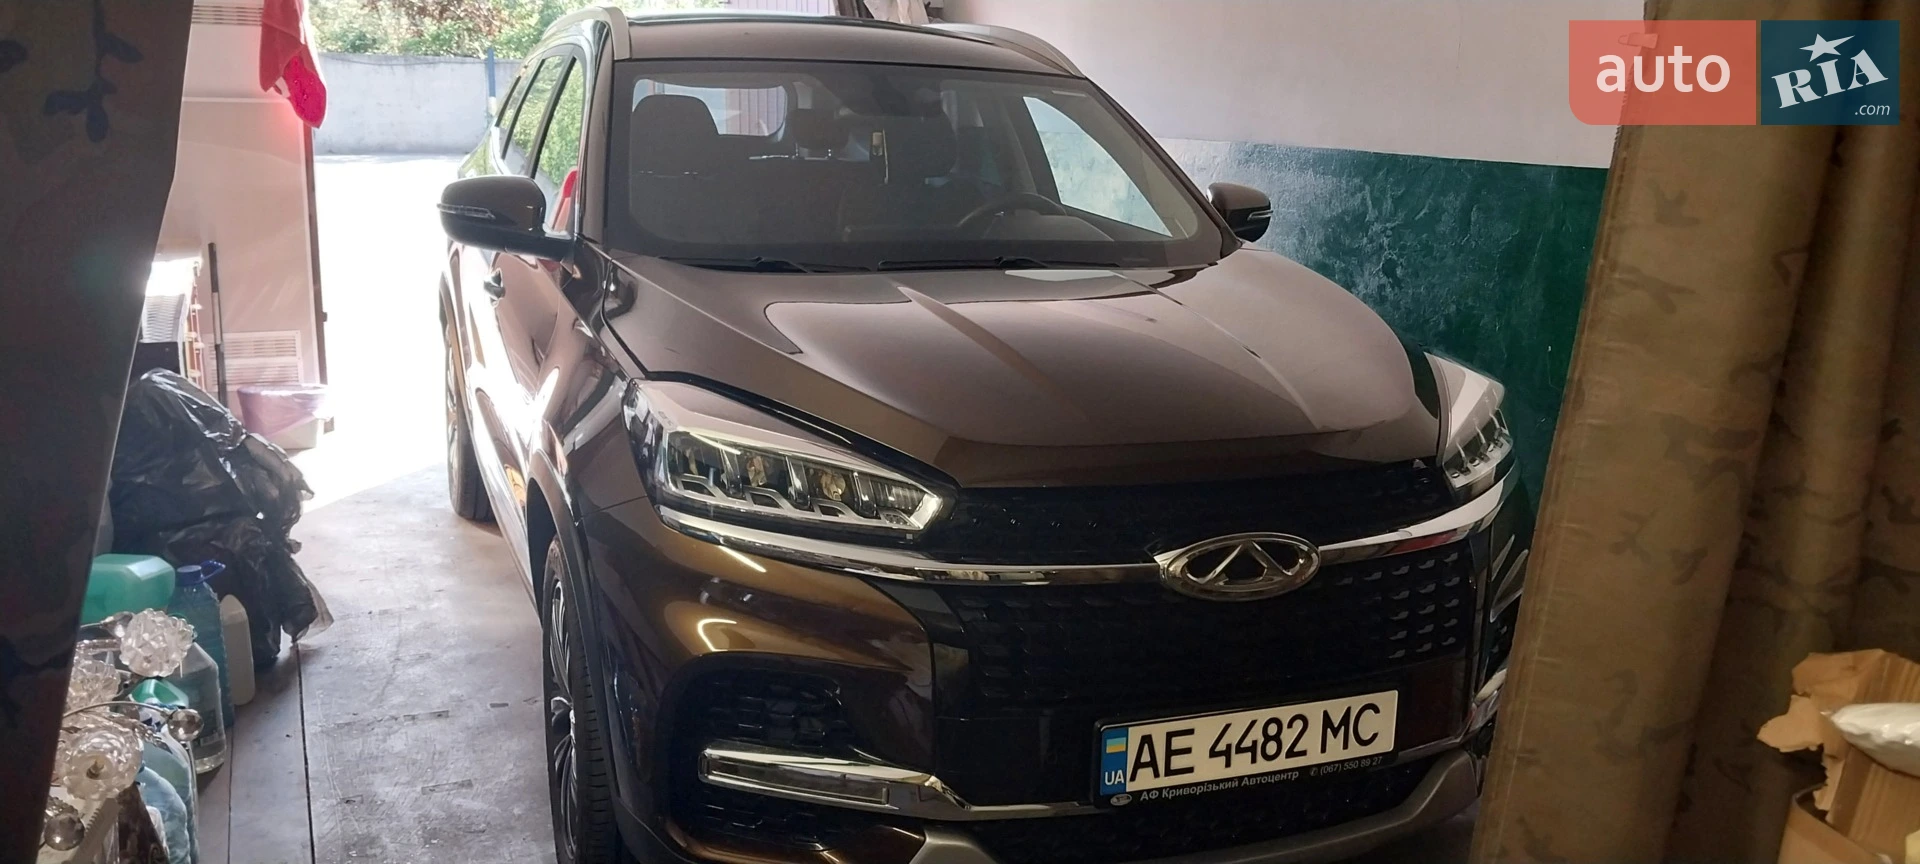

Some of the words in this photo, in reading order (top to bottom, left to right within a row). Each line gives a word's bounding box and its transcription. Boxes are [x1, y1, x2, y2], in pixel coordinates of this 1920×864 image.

[1129, 727, 1196, 783] AE
[1208, 713, 1309, 769] 4482
[1320, 702, 1381, 755] MC
[1104, 769, 1125, 786] UA
[1320, 763, 1342, 776] (067)
[1343, 759, 1359, 771] 550
[1360, 757, 1371, 768] 89
[1140, 790, 1160, 801] АФ
[1162, 778, 1239, 800] Криворізький
[1241, 770, 1300, 787] Автоцентр
